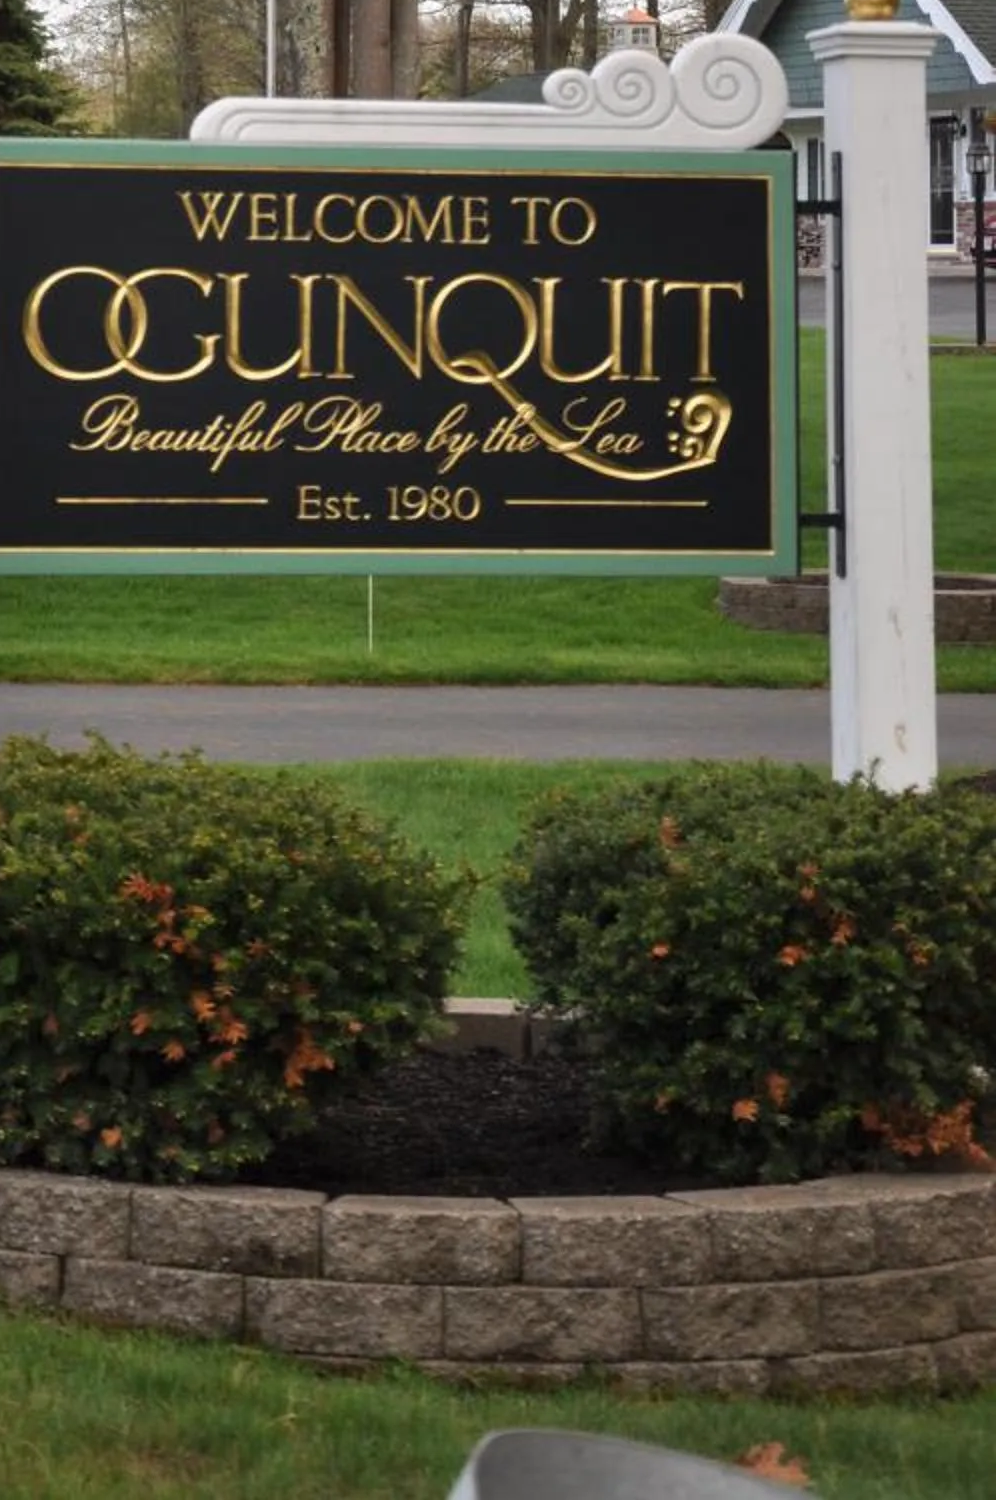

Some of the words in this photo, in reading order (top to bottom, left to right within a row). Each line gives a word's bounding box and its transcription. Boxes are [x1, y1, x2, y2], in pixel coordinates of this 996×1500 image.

[177, 191, 491, 245] WELCOME
[510, 196, 597, 246] TO
[22, 265, 745, 390] OGUNQUIT
[69, 393, 303, 473] Beautiful
[294, 395, 421, 453] Place
[424, 402, 478, 474] by
[482, 408, 541, 453] the
[296, 485, 372, 521] Est.
[385, 485, 482, 521] 1980
